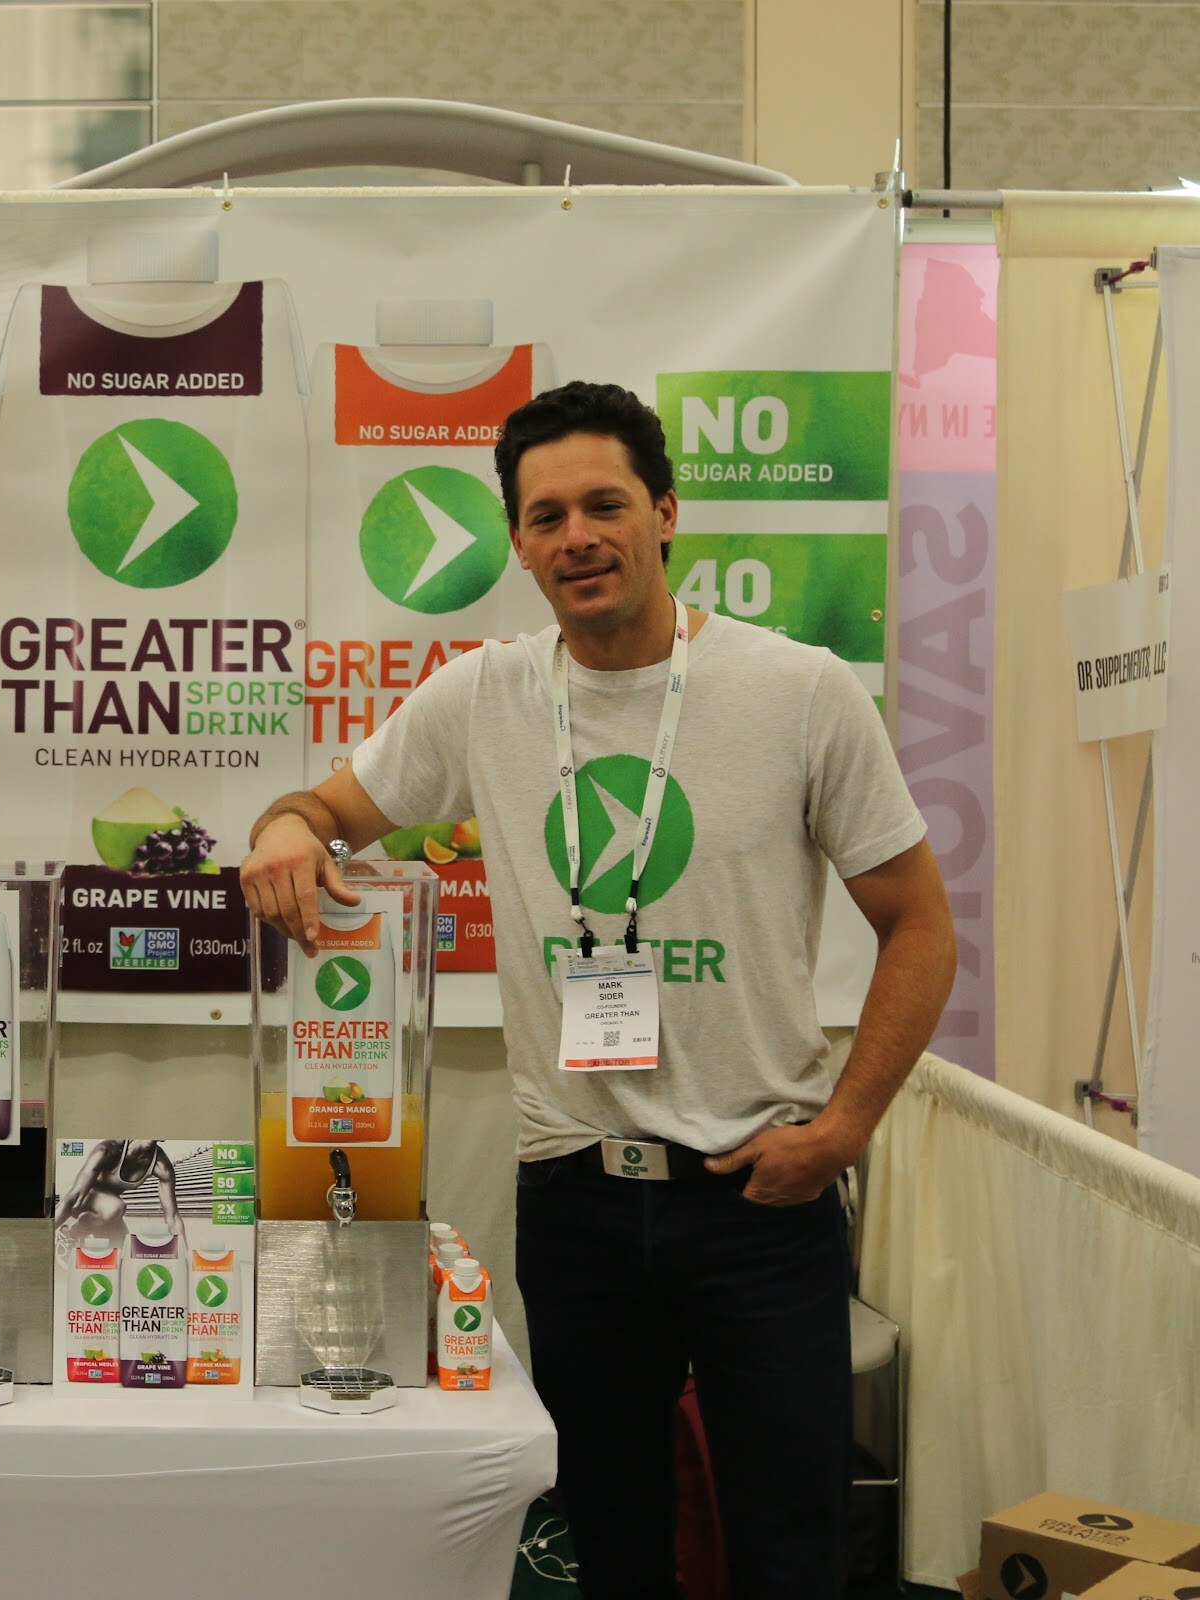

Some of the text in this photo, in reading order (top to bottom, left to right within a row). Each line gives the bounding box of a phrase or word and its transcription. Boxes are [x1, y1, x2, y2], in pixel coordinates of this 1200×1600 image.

[67, 373, 245, 390] NO SUGAR ADDED
[359, 425, 384, 440] NO
[390, 425, 449, 440] SUGAR
[682, 396, 789, 455] NO
[679, 463, 833, 482] SUGAR ADDED
[676, 558, 771, 618] 40
[0, 618, 293, 673] GREATER
[1095, 646, 1151, 689] SUPPLEMENTS,
[1154, 640, 1167, 675] LLC
[2, 680, 304, 736] THAN SPORTS
[186, 712, 290, 736] DRINK
[305, 696, 404, 744] TH
[35, 749, 260, 768] CLEAN HYDRATION
[72, 888, 227, 909] GRAPE VINE
[148, 932, 176, 940] NON
[88, 942, 103, 953] oz
[147, 940, 176, 949] GMO
[189, 939, 247, 957] (330mL)
[147, 949, 176, 957] Project
[115, 959, 176, 967] VERIFIED
[585, 1011, 619, 1019] GREATER
[293, 1021, 389, 1039] GREATER
[293, 1041, 391, 1059] THAN SPORTS
[354, 1051, 388, 1059] DRINK
[217, 1149, 237, 1160] NO
[217, 1177, 235, 1188] 50
[217, 1204, 236, 1215] 2X
[122, 1306, 184, 1319] GREATER
[68, 1322, 102, 1333] THAN
[122, 1319, 161, 1332] THAN
[444, 1334, 489, 1345] GREATER
[444, 1345, 474, 1355] THAN
